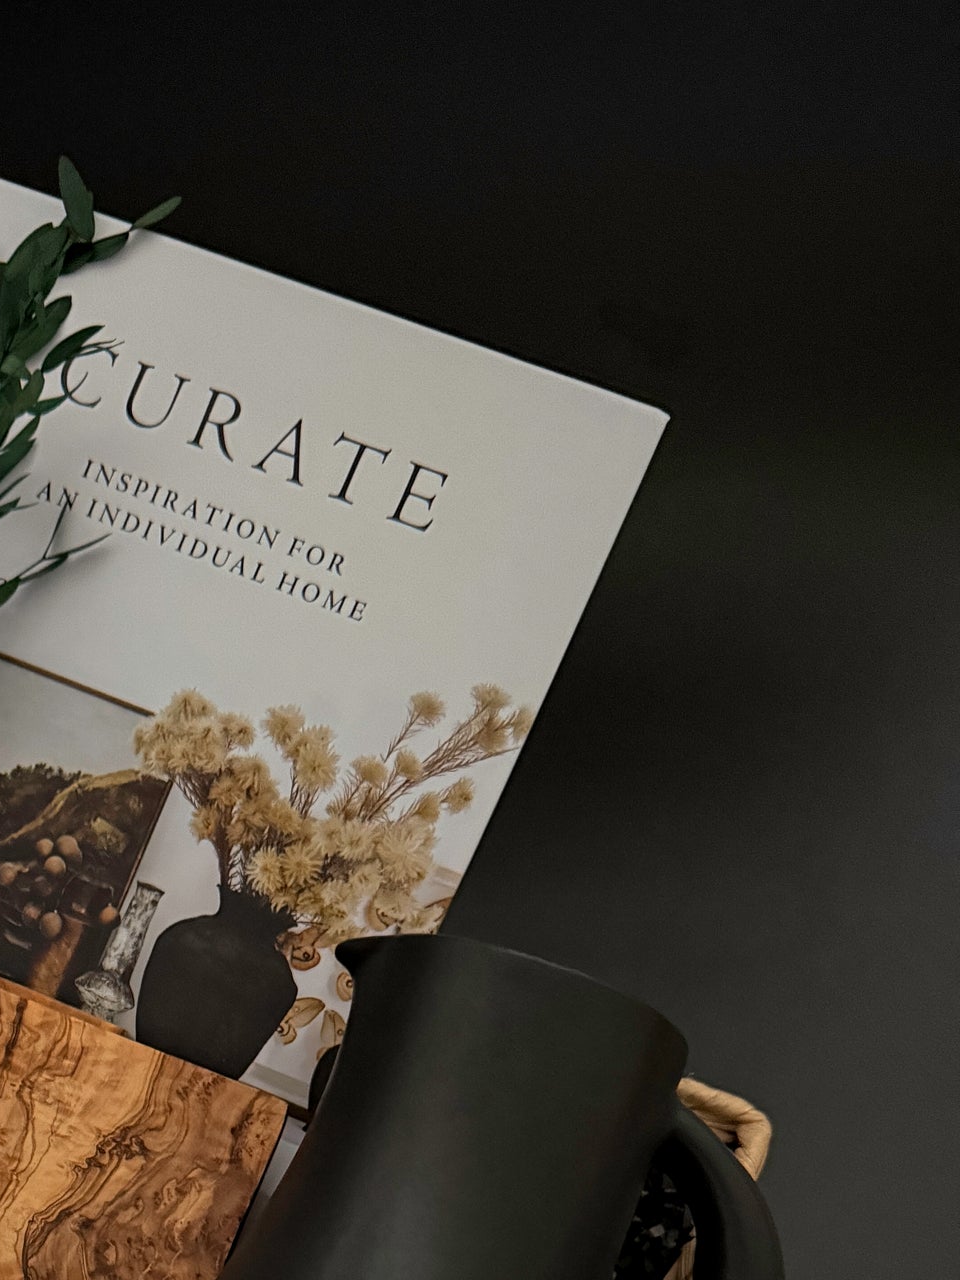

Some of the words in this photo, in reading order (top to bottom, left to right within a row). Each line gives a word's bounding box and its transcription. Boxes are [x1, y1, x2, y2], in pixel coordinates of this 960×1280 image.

[60, 346, 449, 533] CURATE
[36, 481, 79, 512] AN
[86, 503, 267, 583] INDIVIDUAL
[276, 572, 369, 622] HOME
[82, 458, 281, 550] INSPIRATION
[287, 537, 345, 576] FOR
